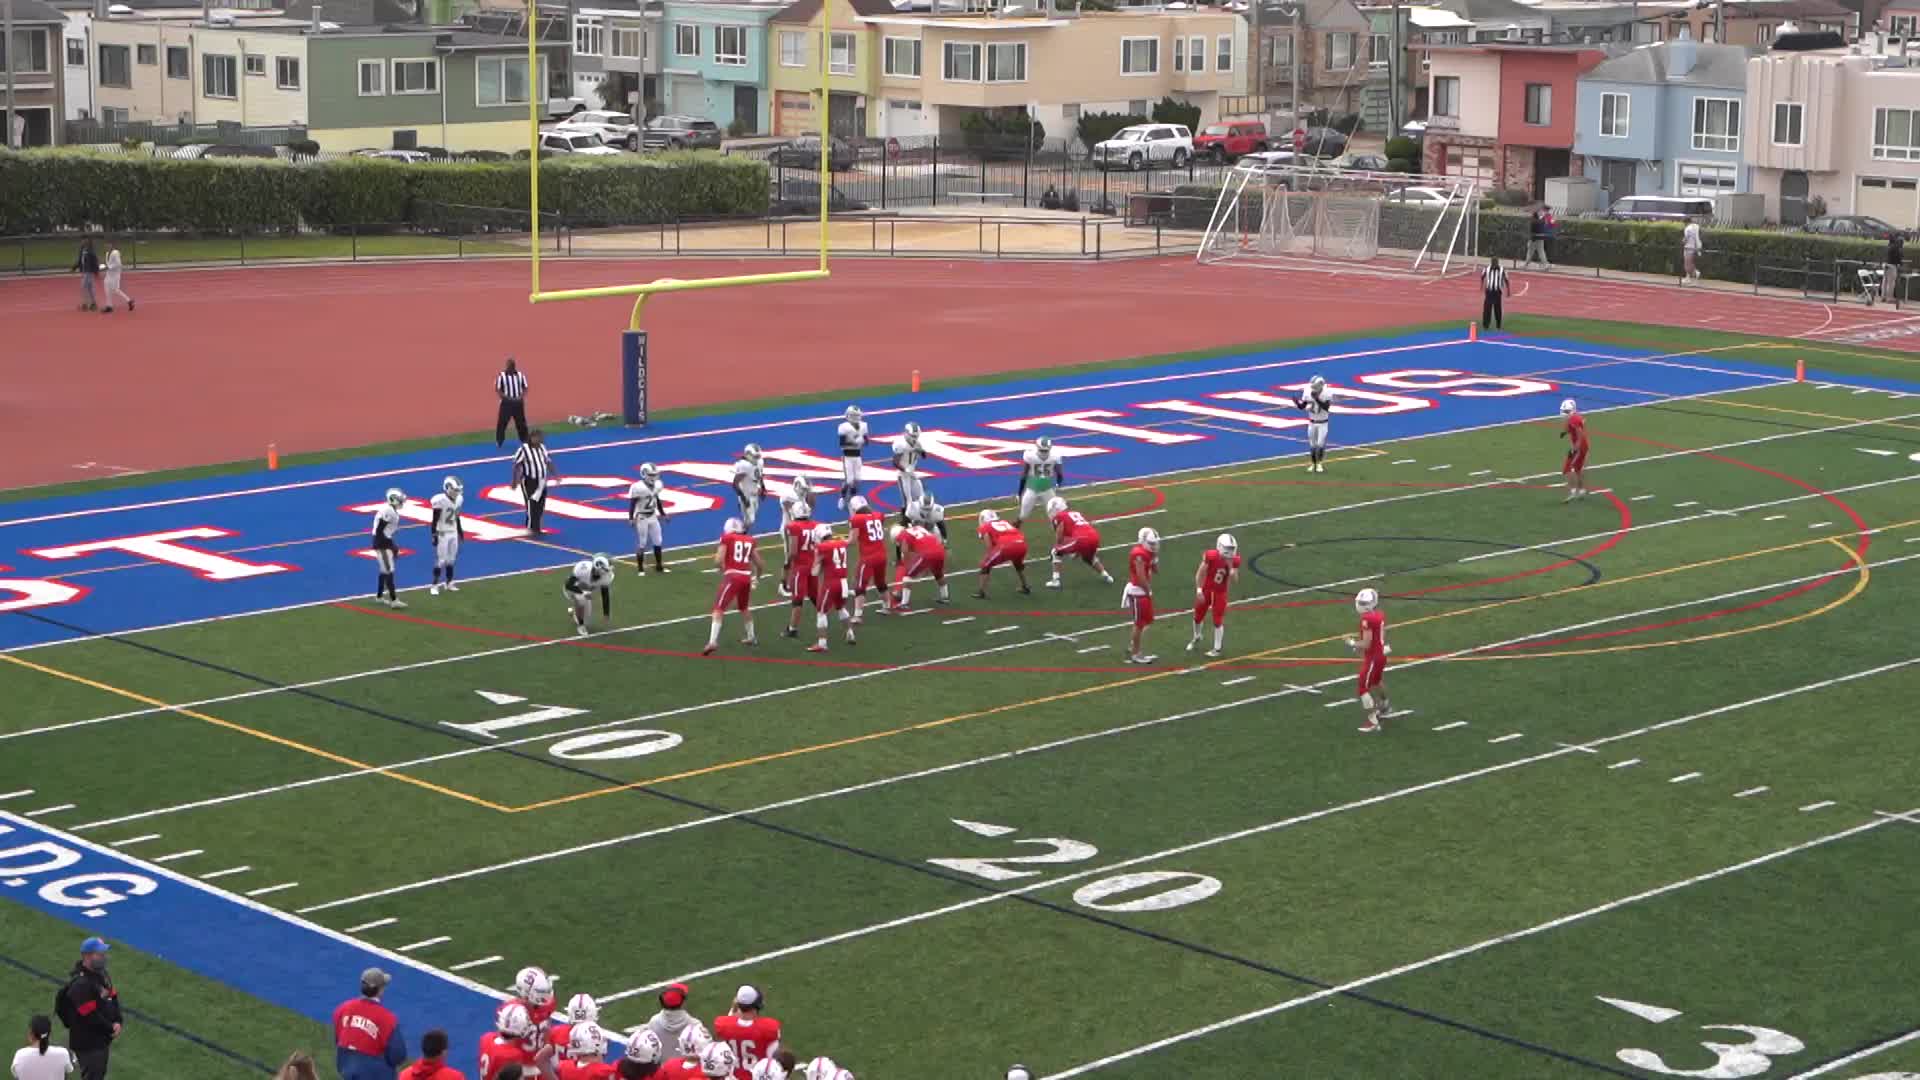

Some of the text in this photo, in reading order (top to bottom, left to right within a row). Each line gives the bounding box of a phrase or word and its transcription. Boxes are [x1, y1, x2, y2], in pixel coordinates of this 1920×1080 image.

[637, 335, 646, 423] WILDCATS
[336, 368, 1559, 543] IGNATIUS
[733, 540, 753, 564] 87
[831, 547, 848, 569] 47
[865, 519, 884, 541] 58
[437, 703, 684, 760] 10
[925, 837, 1223, 912] 20
